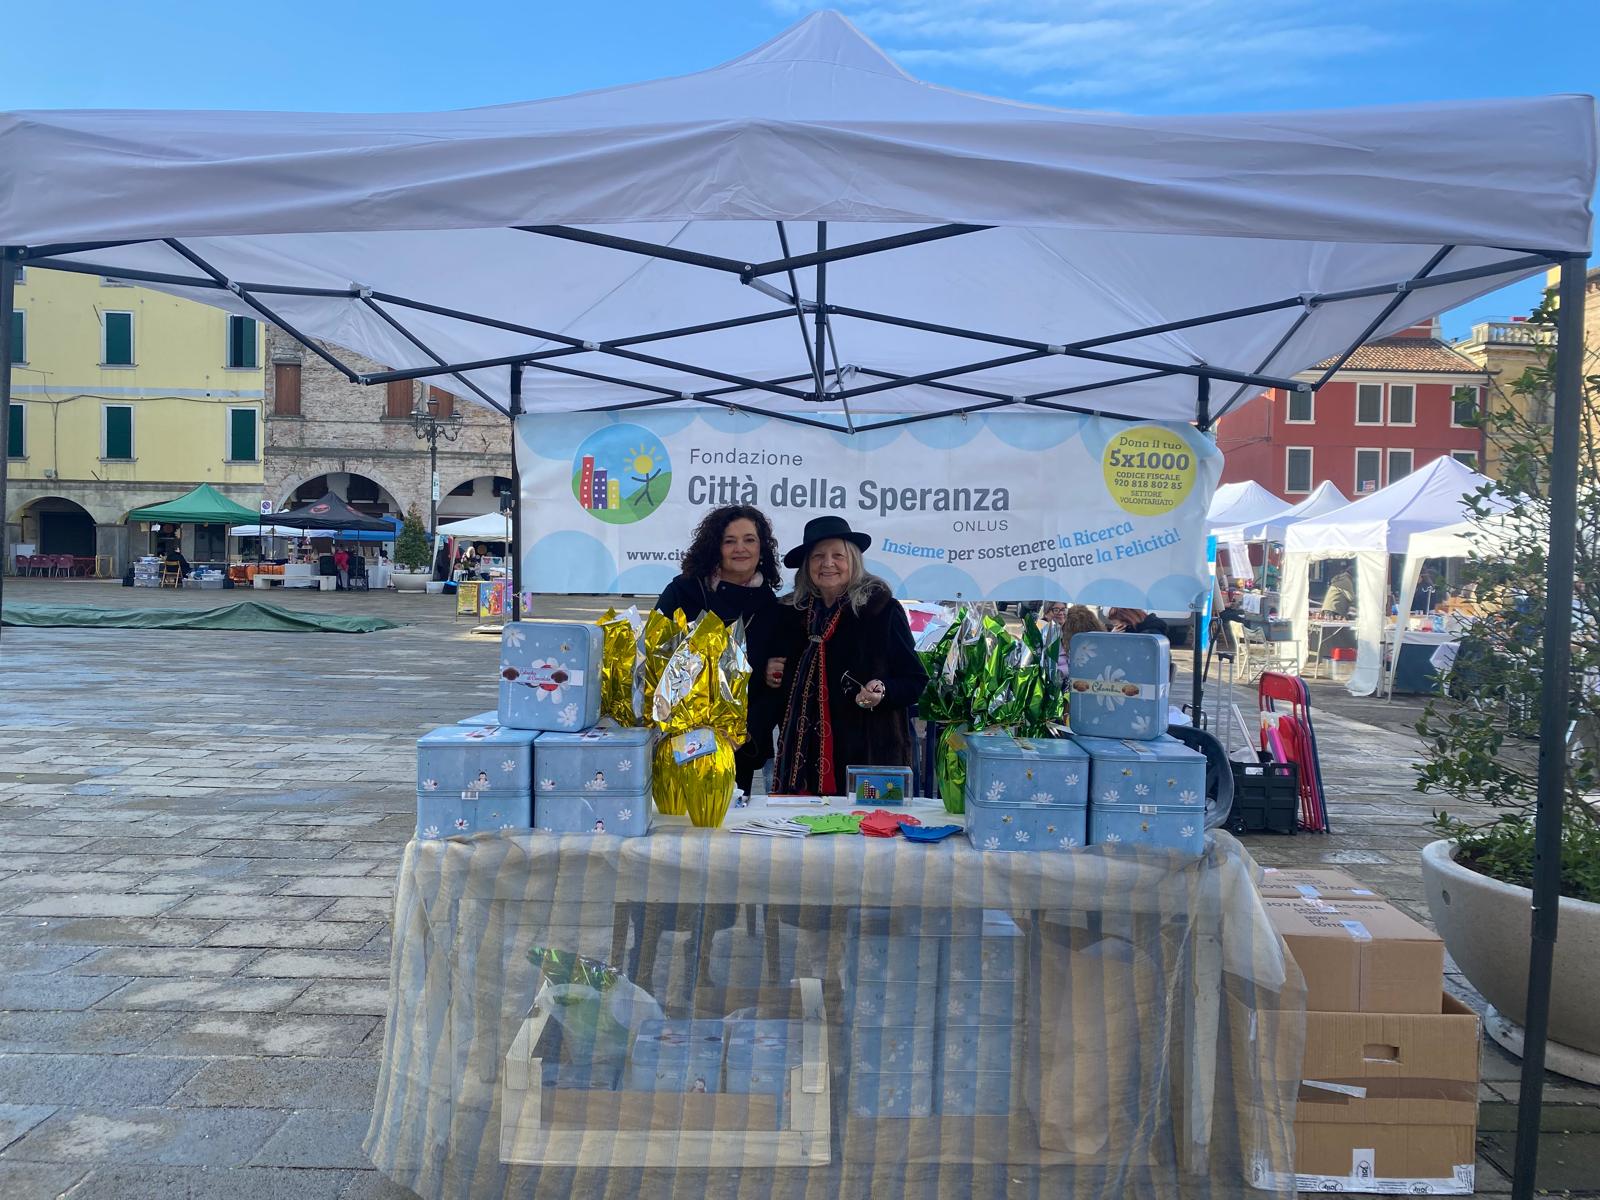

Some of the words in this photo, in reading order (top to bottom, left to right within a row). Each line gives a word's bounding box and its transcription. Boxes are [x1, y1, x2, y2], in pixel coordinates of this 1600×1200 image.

[1120, 436, 1149, 448] Dona
[1163, 441, 1182, 450] tuo
[690, 448, 803, 466] Fondazione
[1109, 448, 1190, 471] 5x1000
[1116, 471, 1146, 479] CODICE
[1147, 473, 1181, 481] FISCALE
[1114, 479, 1130, 487] 920
[1131, 480, 1149, 488] 818
[1151, 481, 1169, 489] 802
[1171, 482, 1183, 490] 85
[688, 475, 758, 505] Città
[770, 477, 847, 509] della
[858, 480, 1010, 517] Speranza
[1131, 490, 1162, 498] SETTORE
[1120, 497, 1174, 506] VOLONTARIATO
[953, 519, 1009, 533] ONLUS
[882, 538, 945, 560] Insieme
[947, 549, 975, 564] per
[977, 536, 1056, 560] sostenere
[1057, 534, 1072, 549] la
[1074, 519, 1135, 547] Ricerca
[1018, 560, 1027, 572] e
[1030, 553, 1094, 573] regalare
[1096, 547, 1113, 564] la
[1116, 527, 1182, 562] Felicità!
